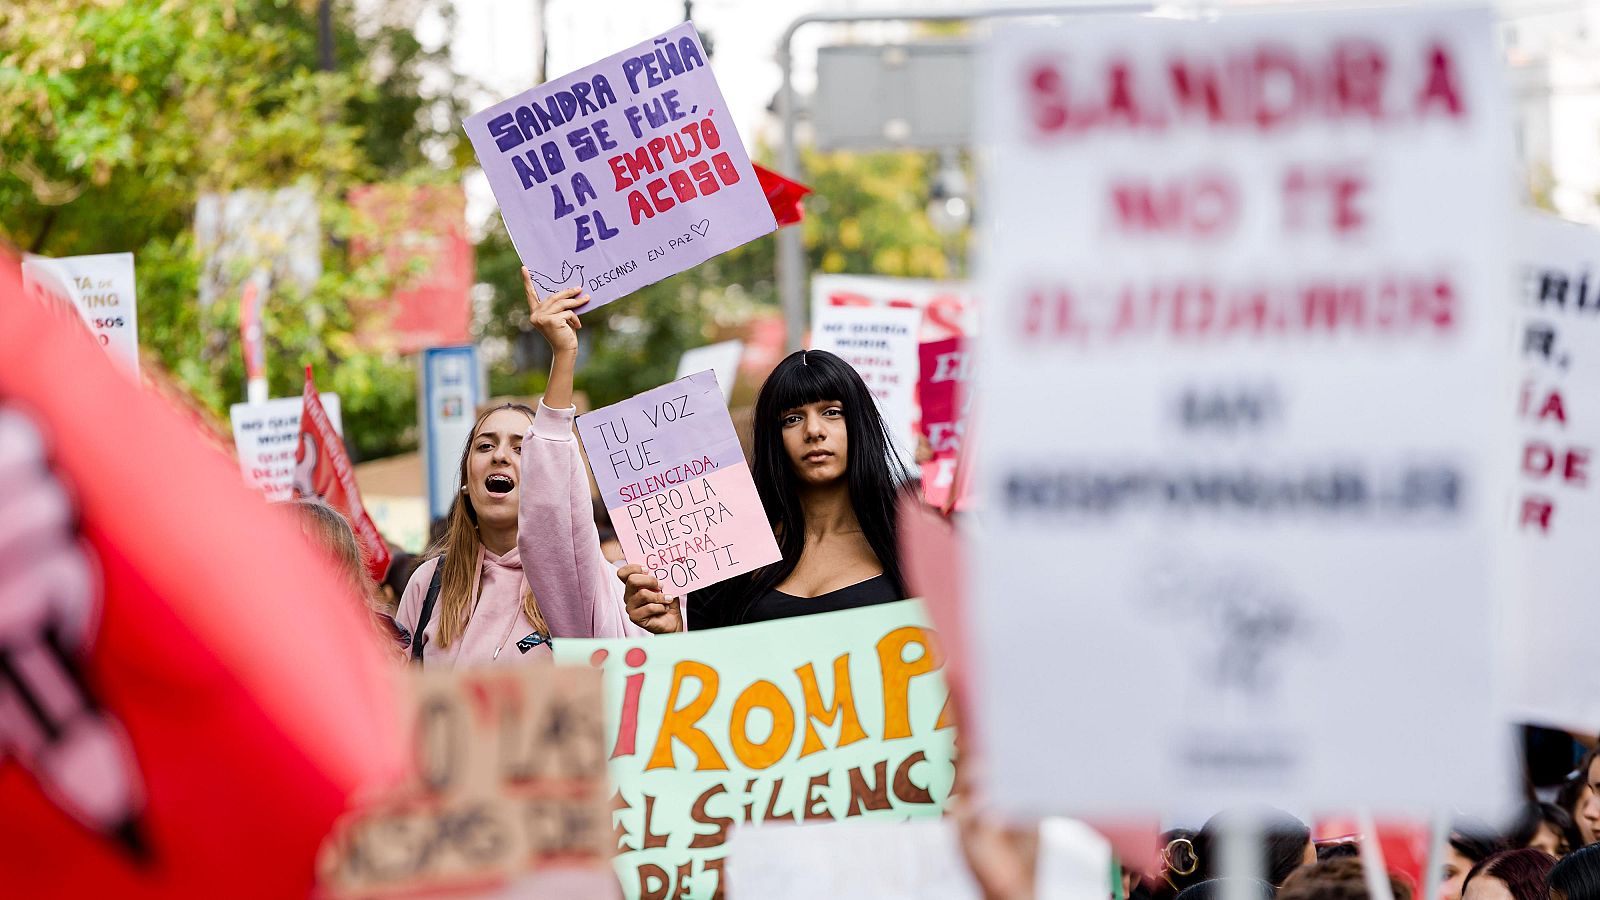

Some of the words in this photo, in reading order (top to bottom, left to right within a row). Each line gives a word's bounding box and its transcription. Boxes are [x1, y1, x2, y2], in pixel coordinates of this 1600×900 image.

[487, 74, 617, 153] SANDRA
[622, 36, 704, 95] PEÑA
[1023, 43, 1467, 138] SANDRA
[511, 140, 566, 190] NO
[566, 118, 618, 162] SE
[623, 89, 699, 139] FUE,
[551, 171, 597, 220] LA
[607, 108, 721, 192] EMPUJÓ
[575, 210, 620, 253] EL
[627, 151, 740, 225] ACOSO
[1107, 168, 1241, 238] NO
[1281, 160, 1370, 237] TE
[588, 260, 638, 292] DESCANSA
[648, 249, 665, 262] EN
[669, 232, 694, 250] PAZ
[94, 316, 124, 328] SOS
[268, 415, 298, 428] QUE
[593, 417, 629, 450] TU
[643, 394, 695, 428] VOZ
[609, 438, 661, 479] FUE
[619, 455, 719, 503] SILENCIADA,
[627, 488, 684, 531] PERO
[687, 477, 716, 506] LA
[636, 501, 733, 555] NUESTRA
[654, 558, 700, 593] POR
[707, 543, 740, 571] TI
